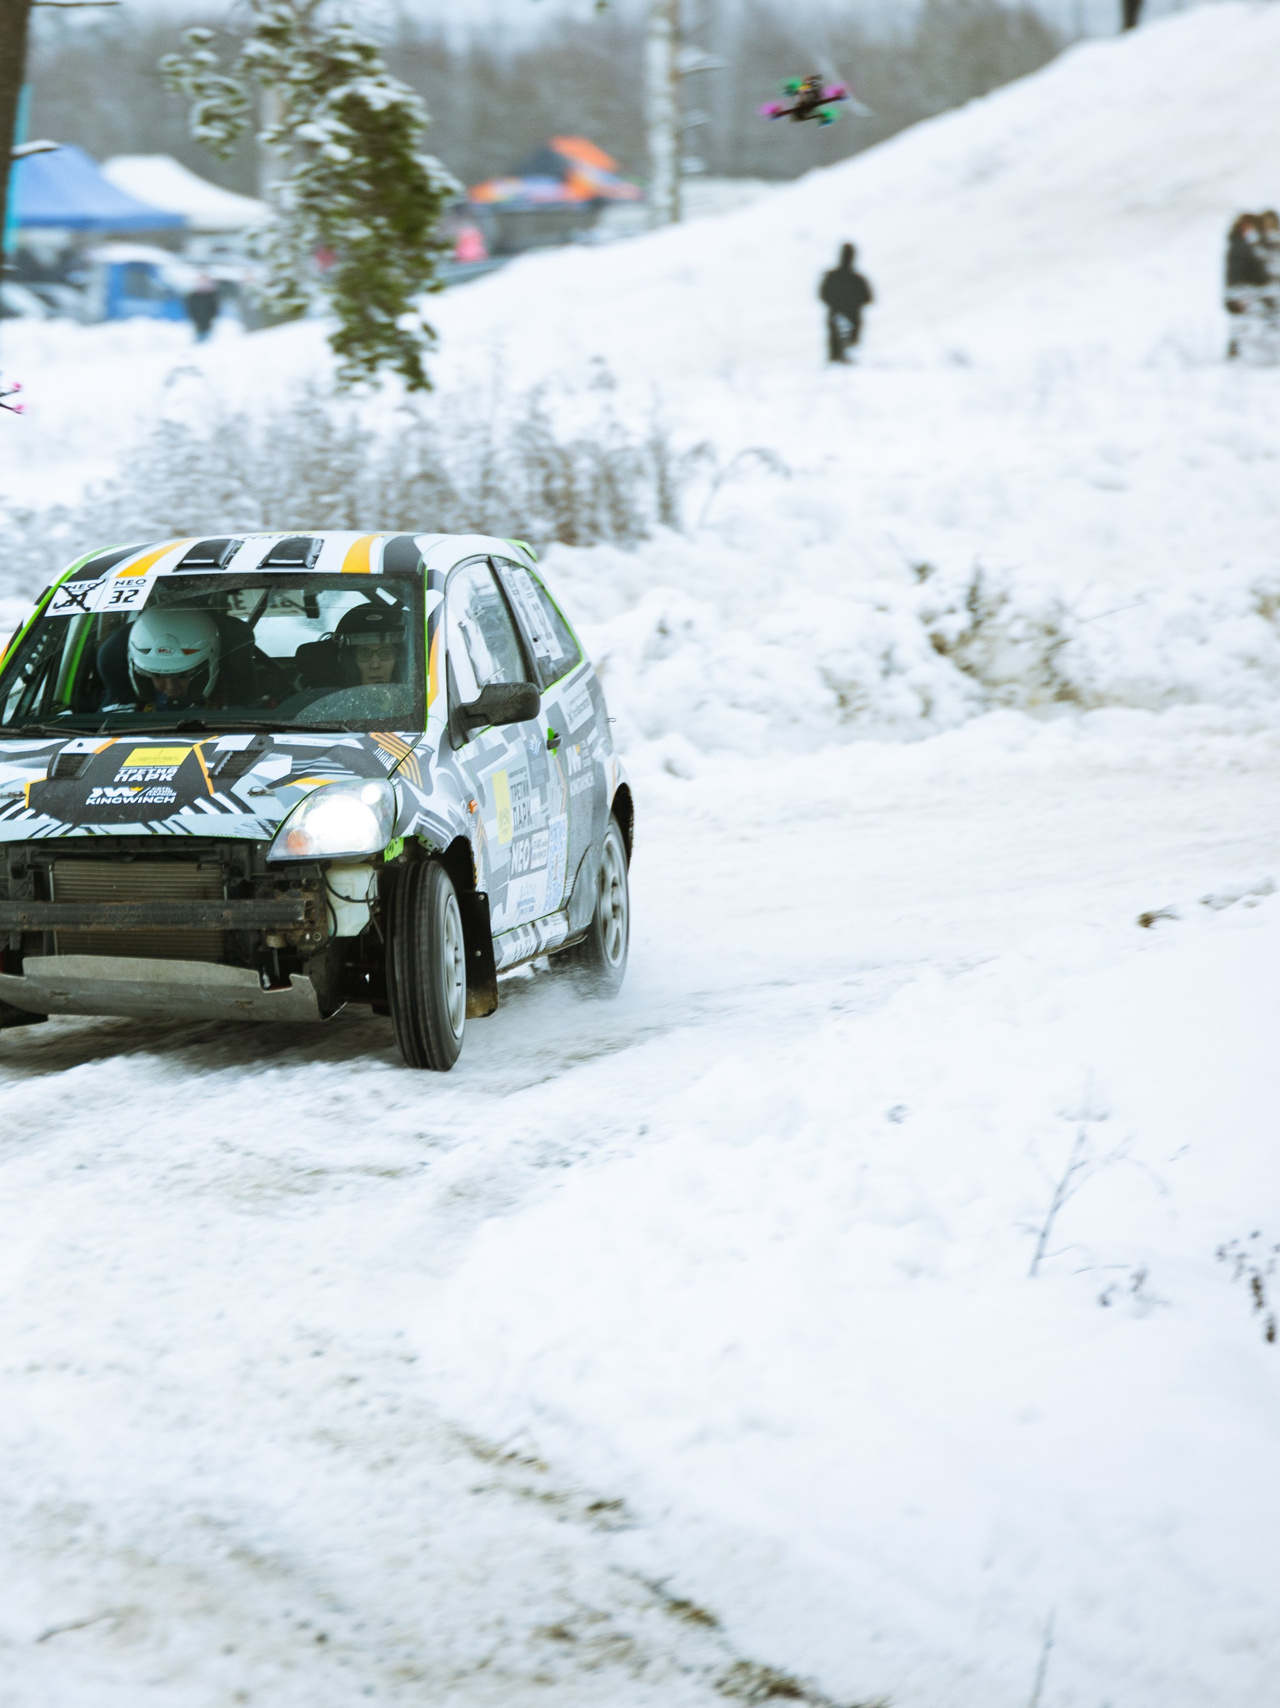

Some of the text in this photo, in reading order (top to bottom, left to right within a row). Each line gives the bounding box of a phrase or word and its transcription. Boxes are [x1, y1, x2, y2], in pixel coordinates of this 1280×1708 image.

[114, 579, 147, 587] NEO
[108, 589, 140, 604] 32
[113, 773, 176, 782] ПАРК
[85, 796, 177, 805] KINGWINCH
[512, 801, 532, 832] ПАРК
[511, 837, 531, 875] NEO
